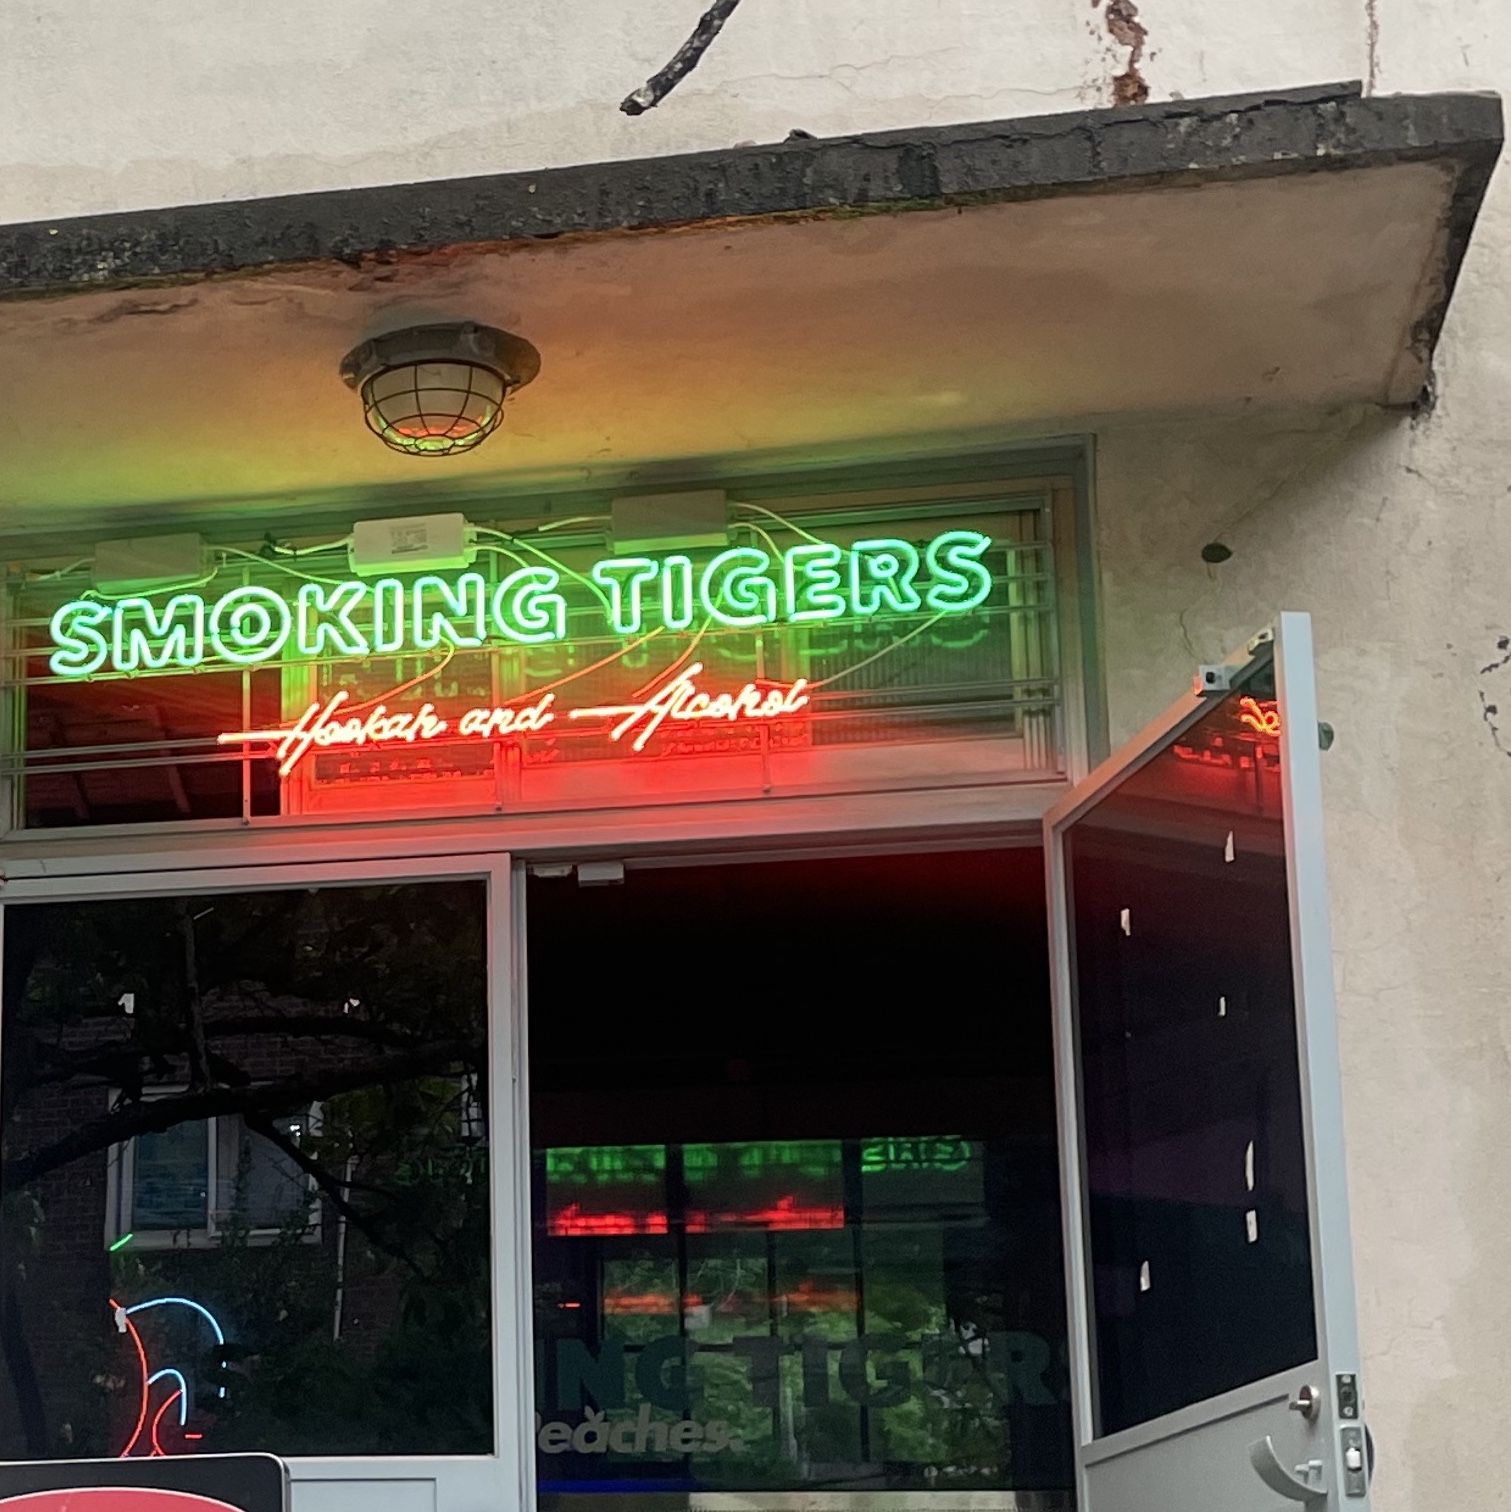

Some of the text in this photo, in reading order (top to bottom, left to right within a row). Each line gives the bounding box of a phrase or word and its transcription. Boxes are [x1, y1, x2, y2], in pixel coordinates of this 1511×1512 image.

[49, 530, 993, 676] SMOKING TIGERS
[459, 692, 556, 738] and
